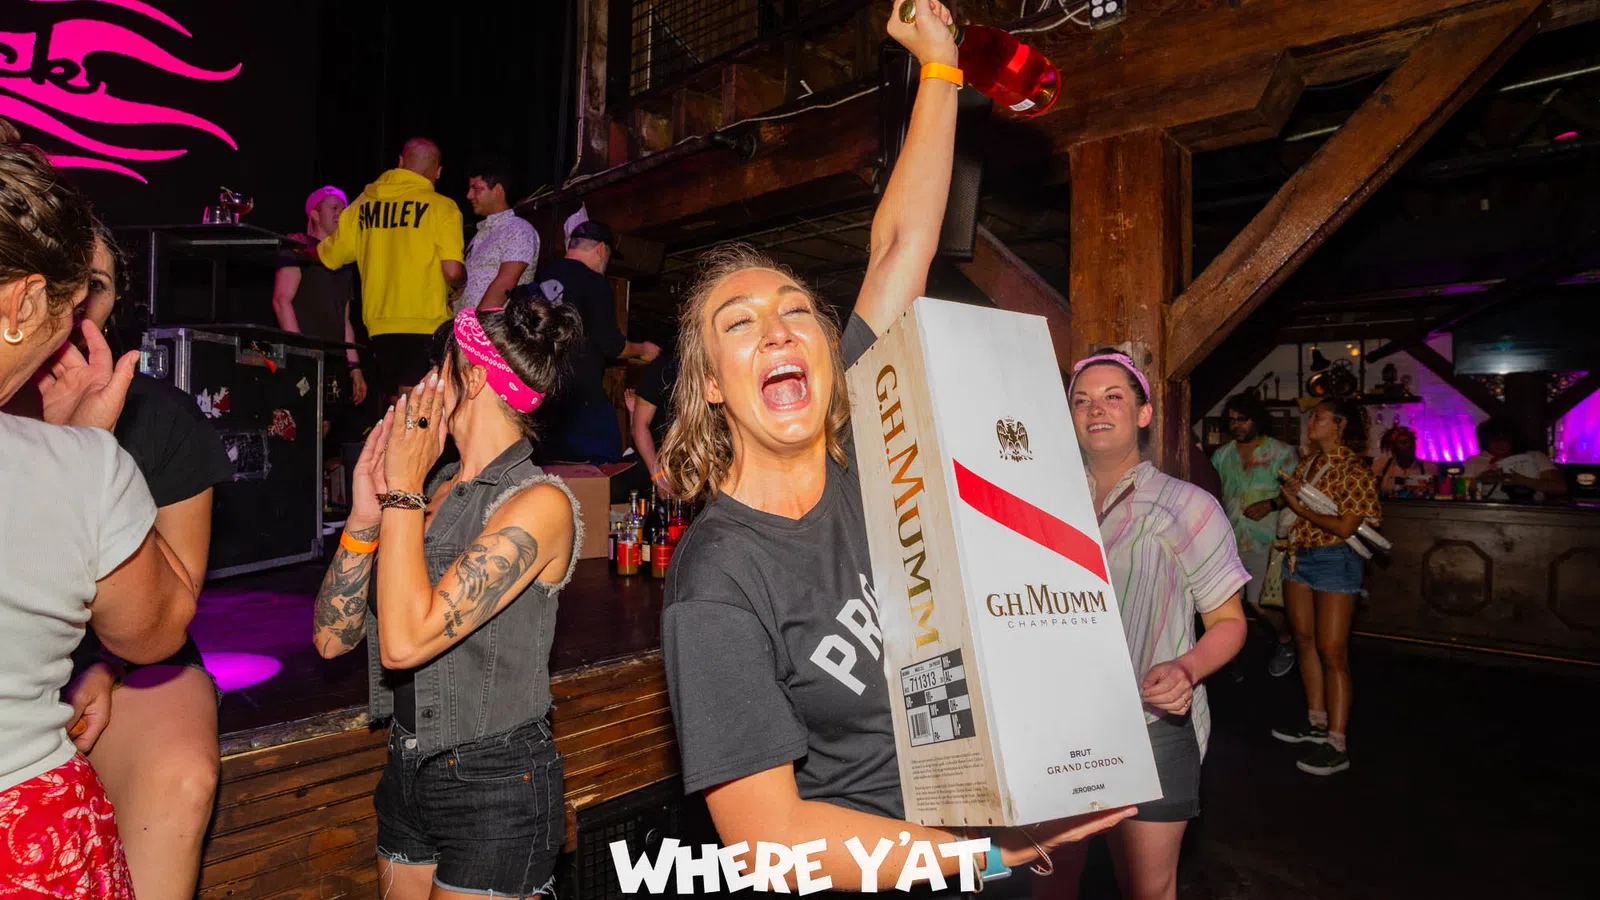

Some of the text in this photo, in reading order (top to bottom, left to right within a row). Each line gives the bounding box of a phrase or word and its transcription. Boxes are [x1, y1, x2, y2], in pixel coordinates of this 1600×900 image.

[1007, 616, 1098, 629] CHAMPAGNE
[909, 671, 937, 692] 711313
[1069, 748, 1092, 758] BRUT
[1046, 756, 1125, 775] GRAND CORDON
[1072, 783, 1106, 795] JEROBOAM
